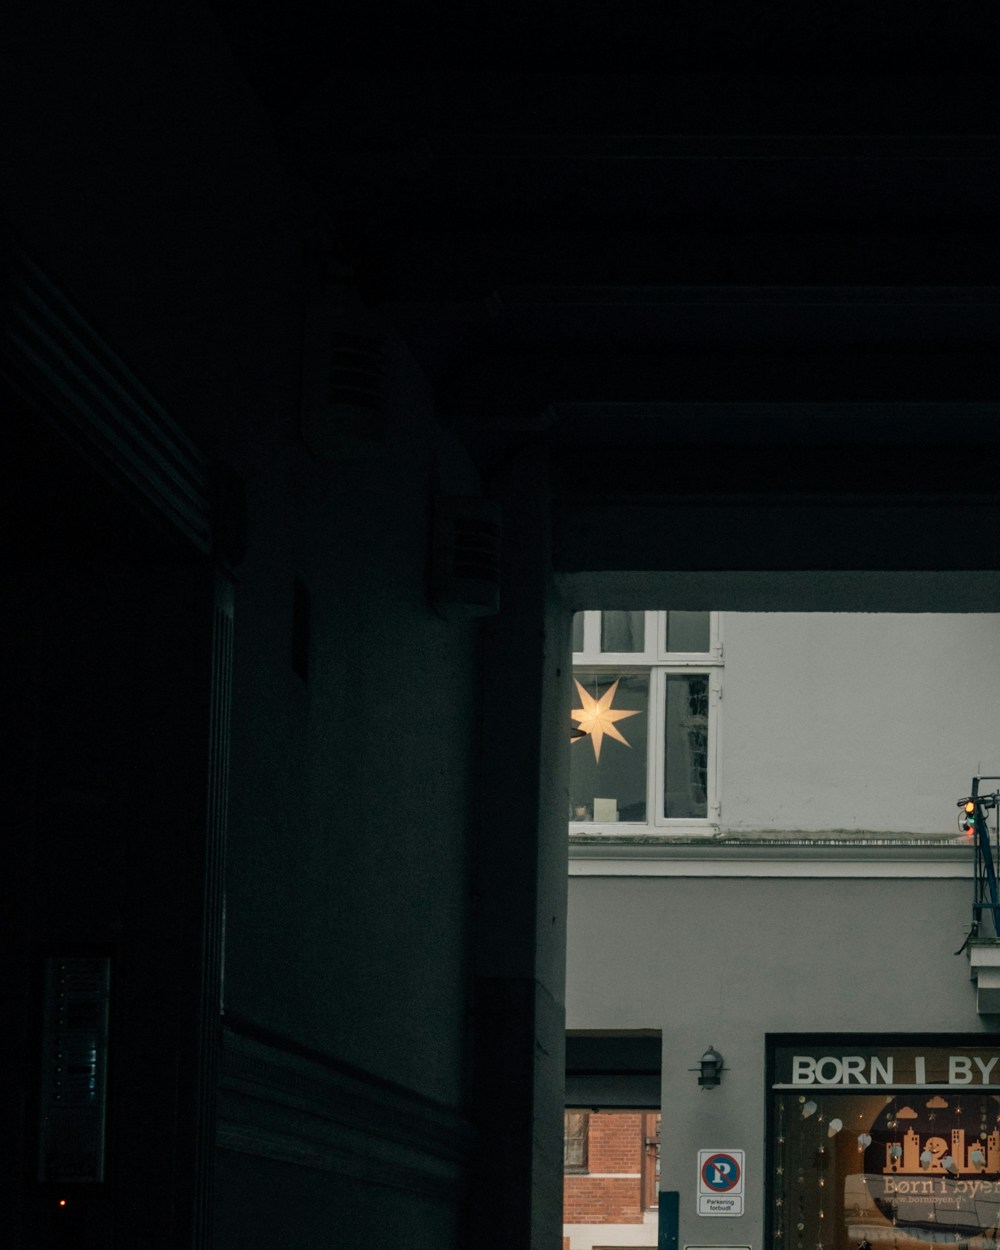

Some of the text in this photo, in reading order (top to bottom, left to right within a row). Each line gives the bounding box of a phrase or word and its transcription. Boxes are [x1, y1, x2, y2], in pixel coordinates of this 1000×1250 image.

[791, 1056, 894, 1085] BORN
[915, 1056, 926, 1085] I
[883, 1176, 935, 1194] Børn
[940, 1176, 948, 1194] i
